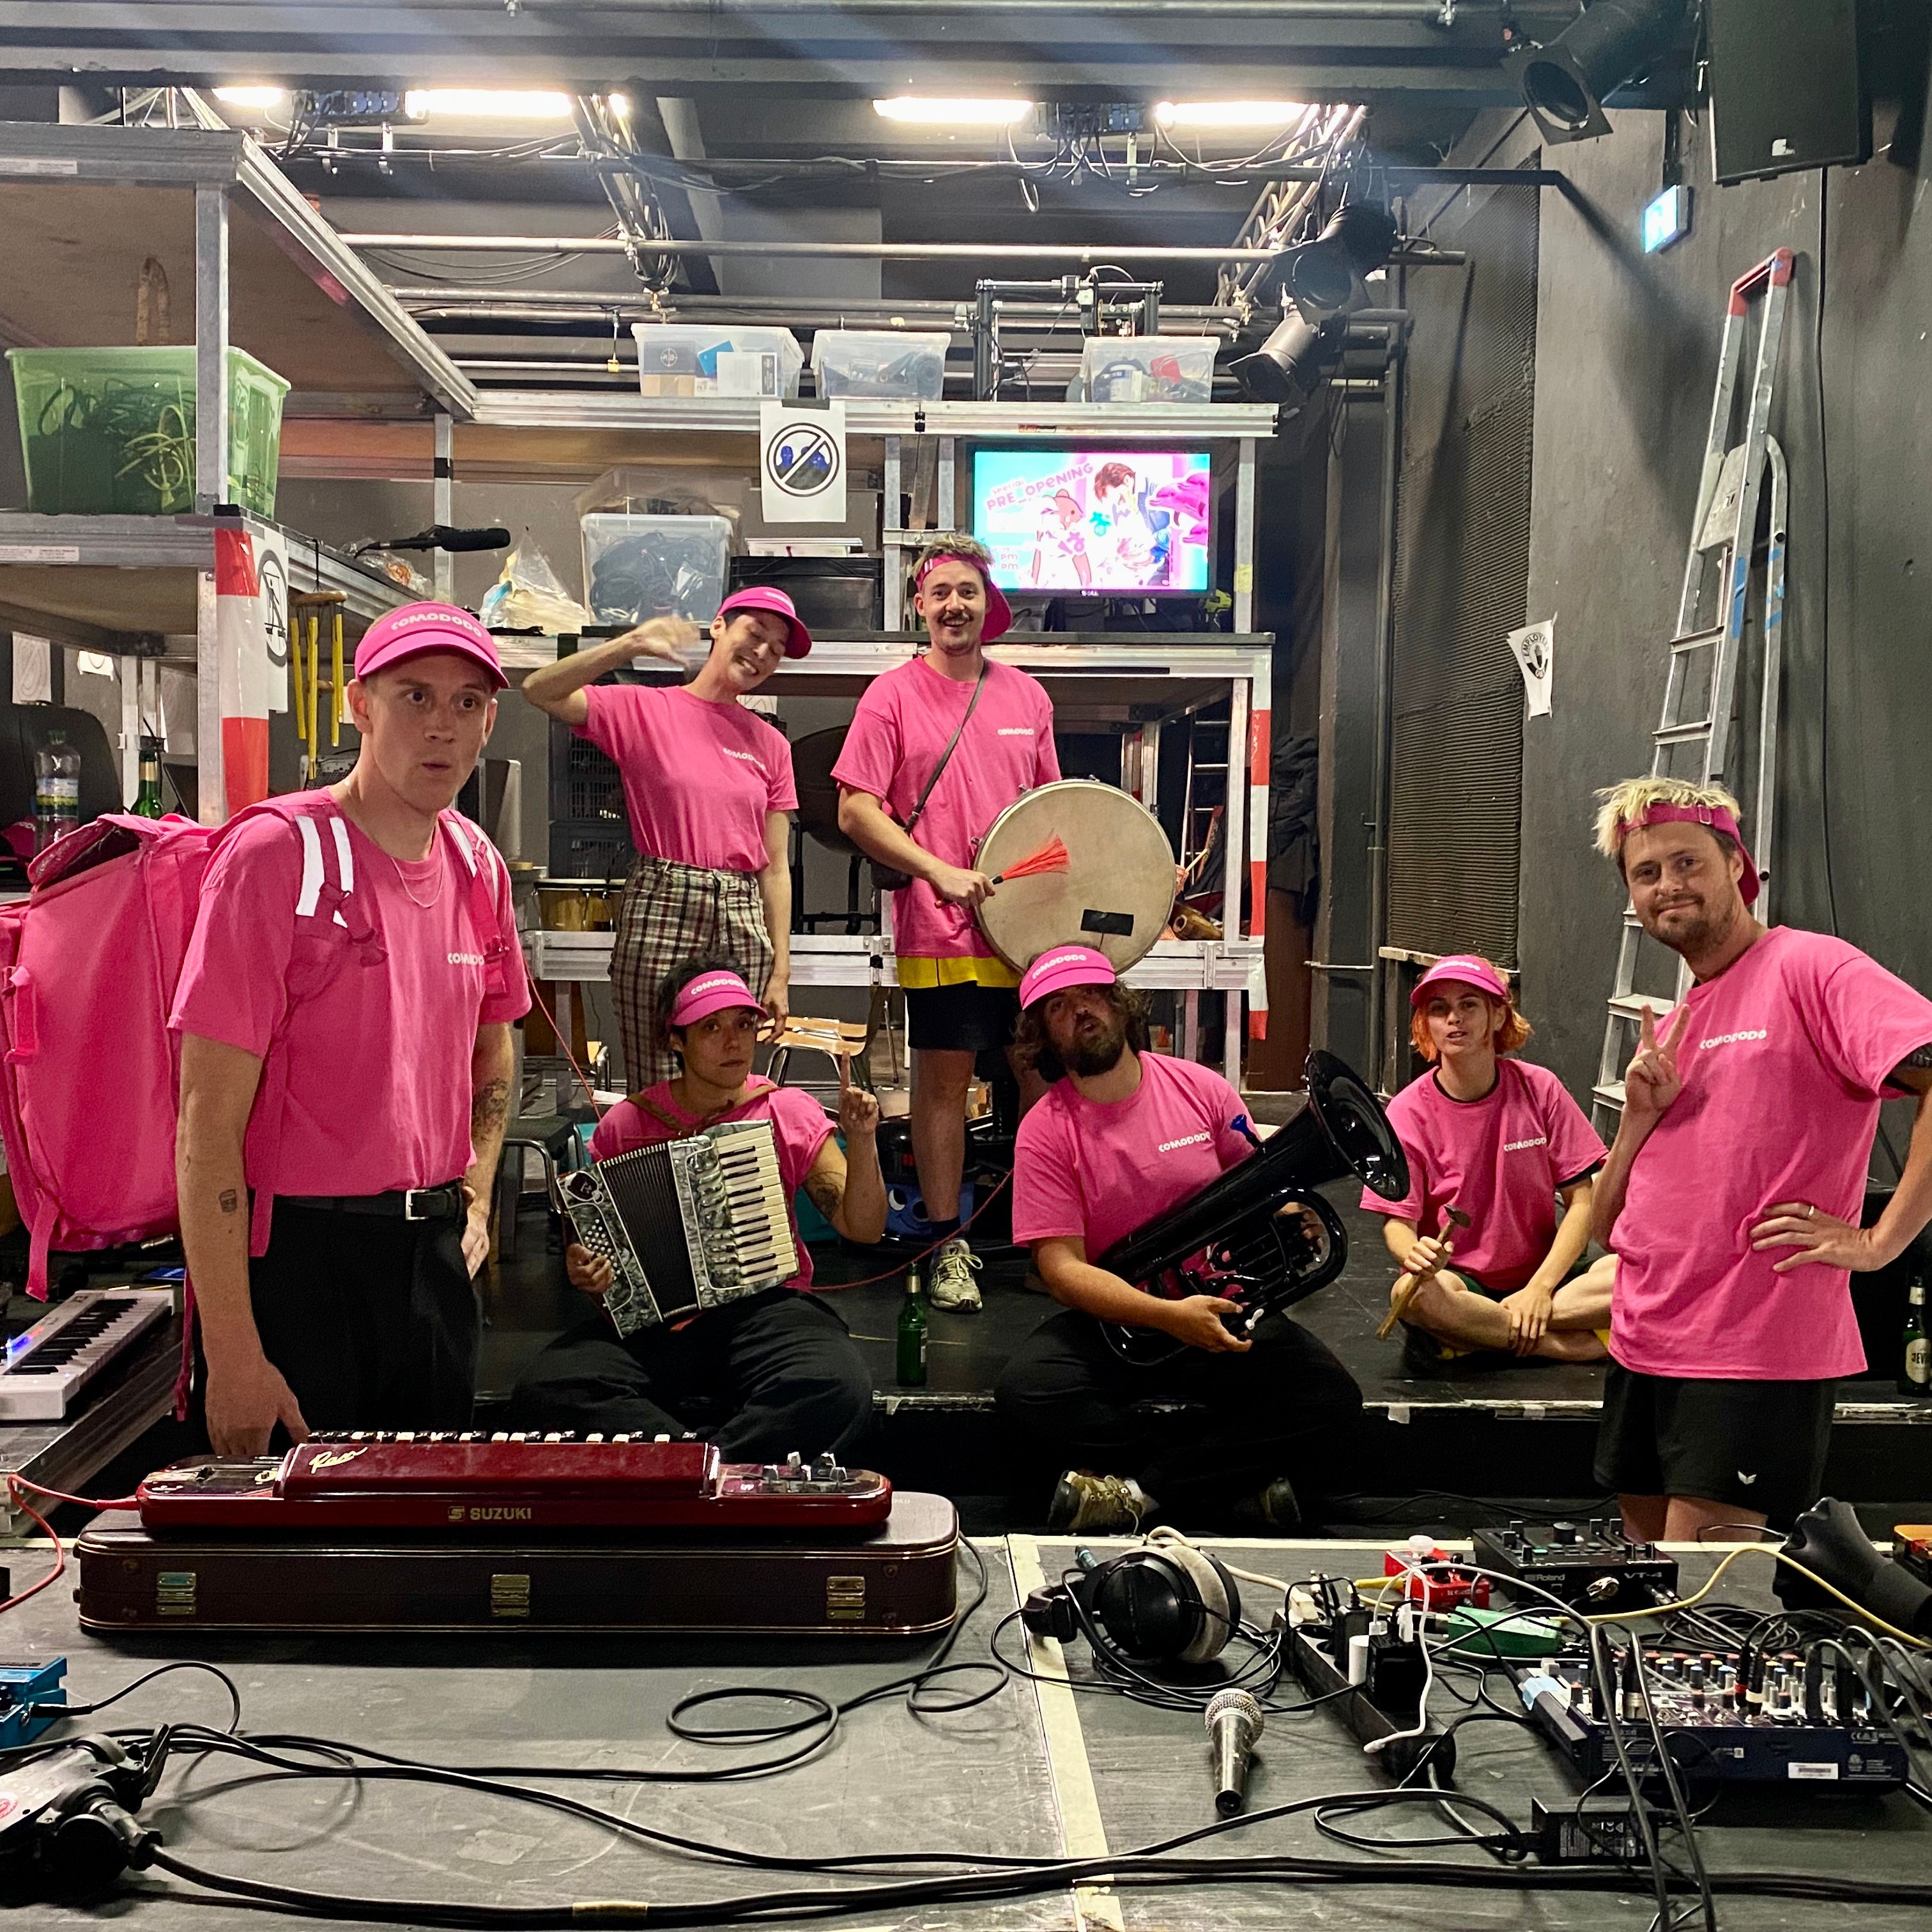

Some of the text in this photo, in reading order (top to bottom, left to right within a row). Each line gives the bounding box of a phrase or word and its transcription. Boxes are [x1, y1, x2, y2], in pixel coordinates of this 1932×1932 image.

[391, 613, 482, 638] COMODODO
[1032, 954, 1087, 979] COMODODO
[1699, 1029, 1767, 1050] COMODODO
[470, 1507, 532, 1521] SUZUKI
[1537, 1573, 1565, 1581] Roland
